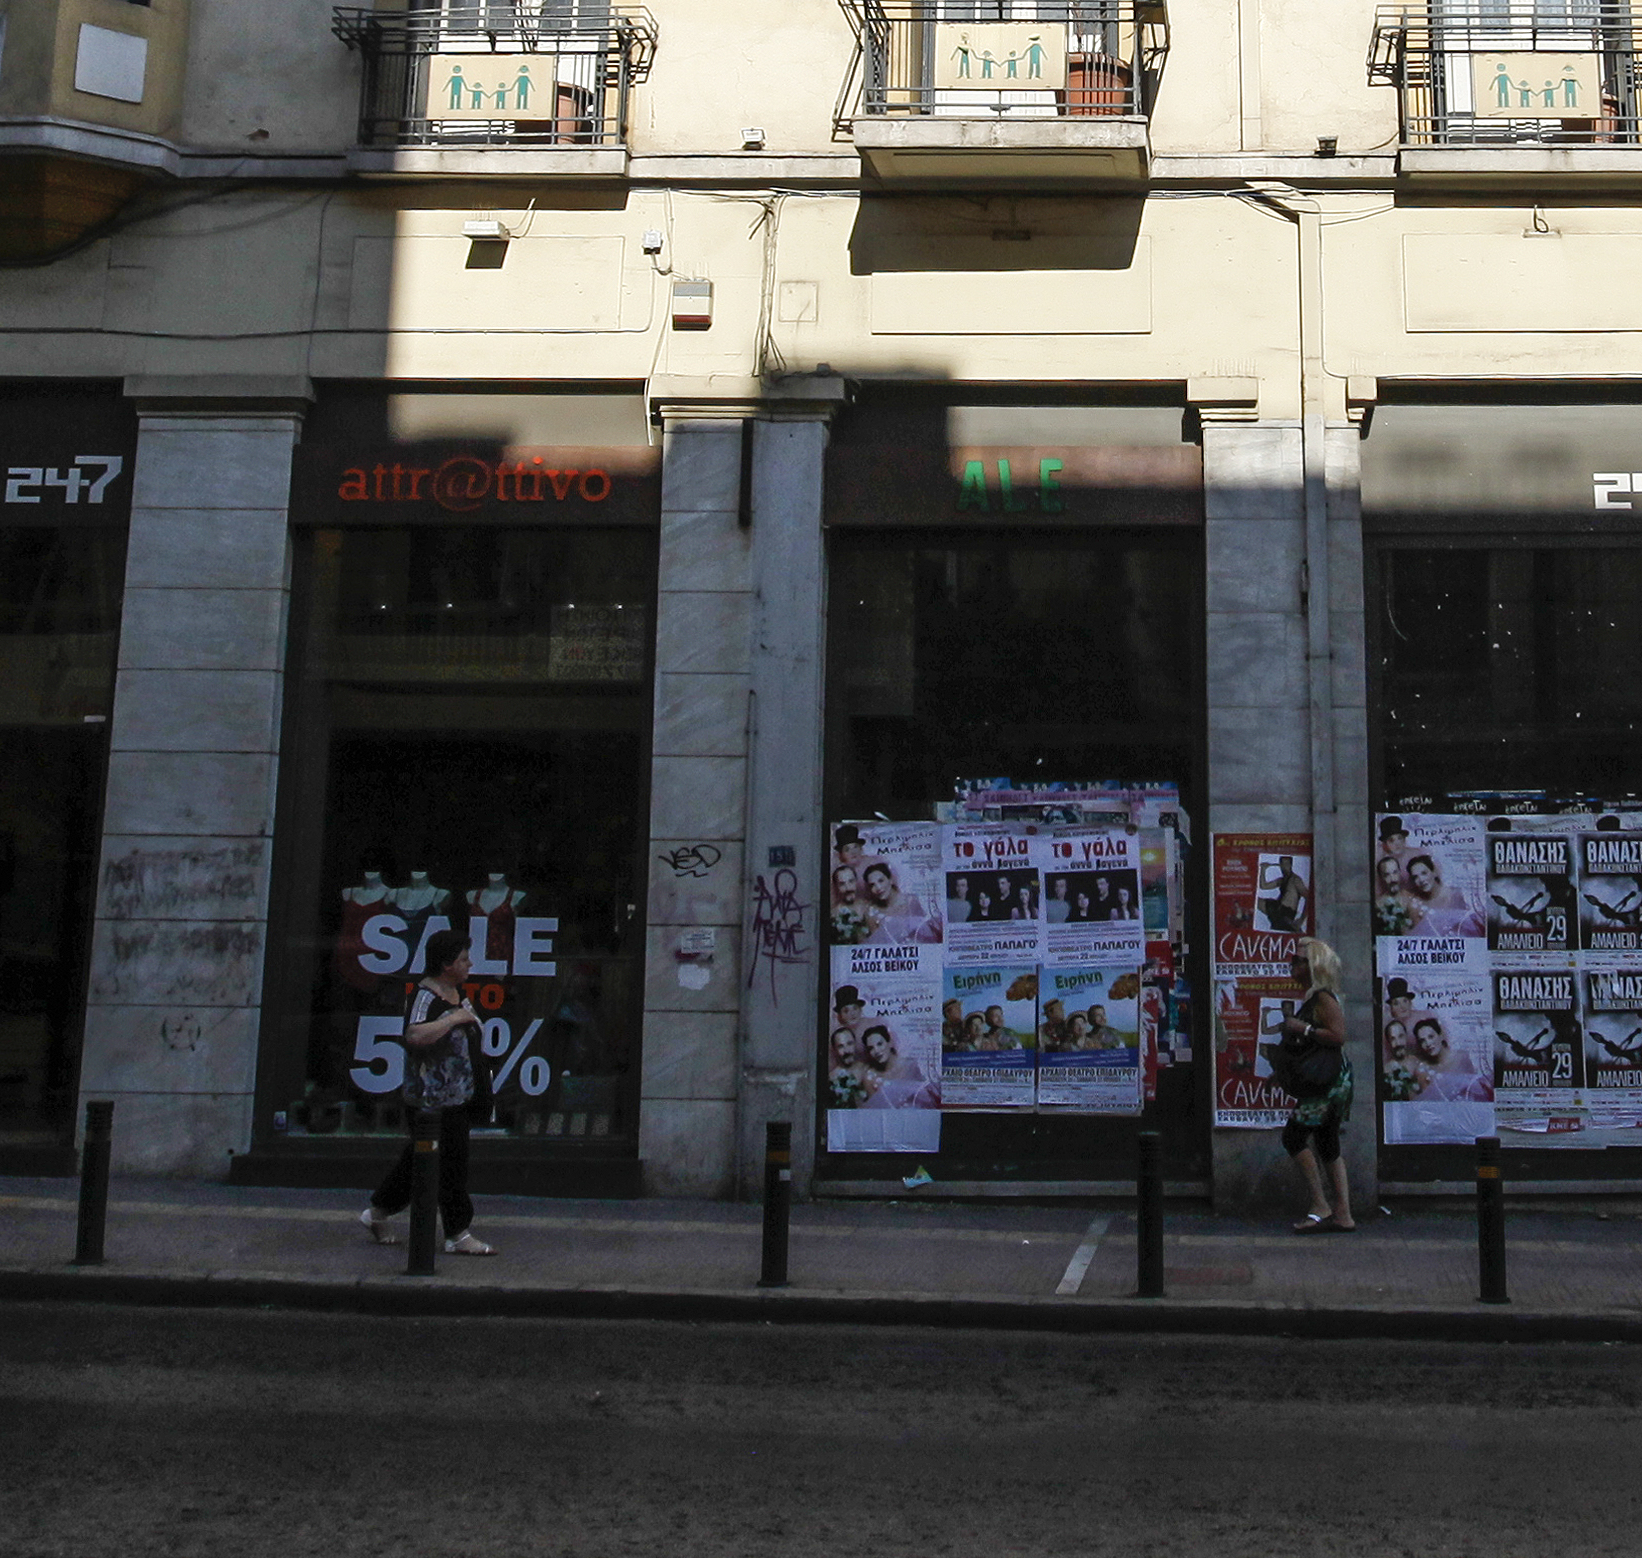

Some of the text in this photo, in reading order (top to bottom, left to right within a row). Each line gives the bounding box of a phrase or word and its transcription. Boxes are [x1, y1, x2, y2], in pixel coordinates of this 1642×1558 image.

[338, 456, 612, 512] attr@ttivo
[954, 836, 1028, 860] το γάλα
[1052, 837, 1127, 861] το γάλα
[1494, 842, 1567, 864] ΘΑΝΑΣΗΣ
[1546, 915, 1567, 941] 29
[995, 940, 1038, 950] ΠΑΠΑΓΟ
[1093, 939, 1141, 951] ΠΑΠΑΓΟΥ
[1219, 932, 1297, 961] CAVEMA
[1398, 939, 1465, 952] 24/7 ΓΑΛΑΤΣΙ
[1497, 933, 1544, 949] ΑΜΑΛΙΕΙΟ
[1591, 932, 1636, 949] ΑΜΑΛΙΕΙΟ
[851, 946, 919, 961] 24/7 ΓΑΛΑΤΣΙ
[1398, 954, 1428, 965] ΑΛΣΟΣ
[851, 962, 883, 974] ΑΛΣΟΣ
[953, 971, 1001, 990] Ειρήνη
[1055, 971, 1103, 991] Ειρήνη
[1499, 977, 1573, 1000] ΘΑΝΑΣΗΣ
[464, 982, 505, 1010] TO
[349, 1015, 551, 1096] 5%
[942, 1068, 963, 1078] ΡΧΑΙΟ
[1551, 1052, 1573, 1079] 29
[1502, 1070, 1549, 1087] ΑΜΑΛΙΕΙΟ
[1596, 1070, 1642, 1087] ΑΜΑΛΙΕΙΟ
[1220, 1078, 1299, 1108] CAVEM
